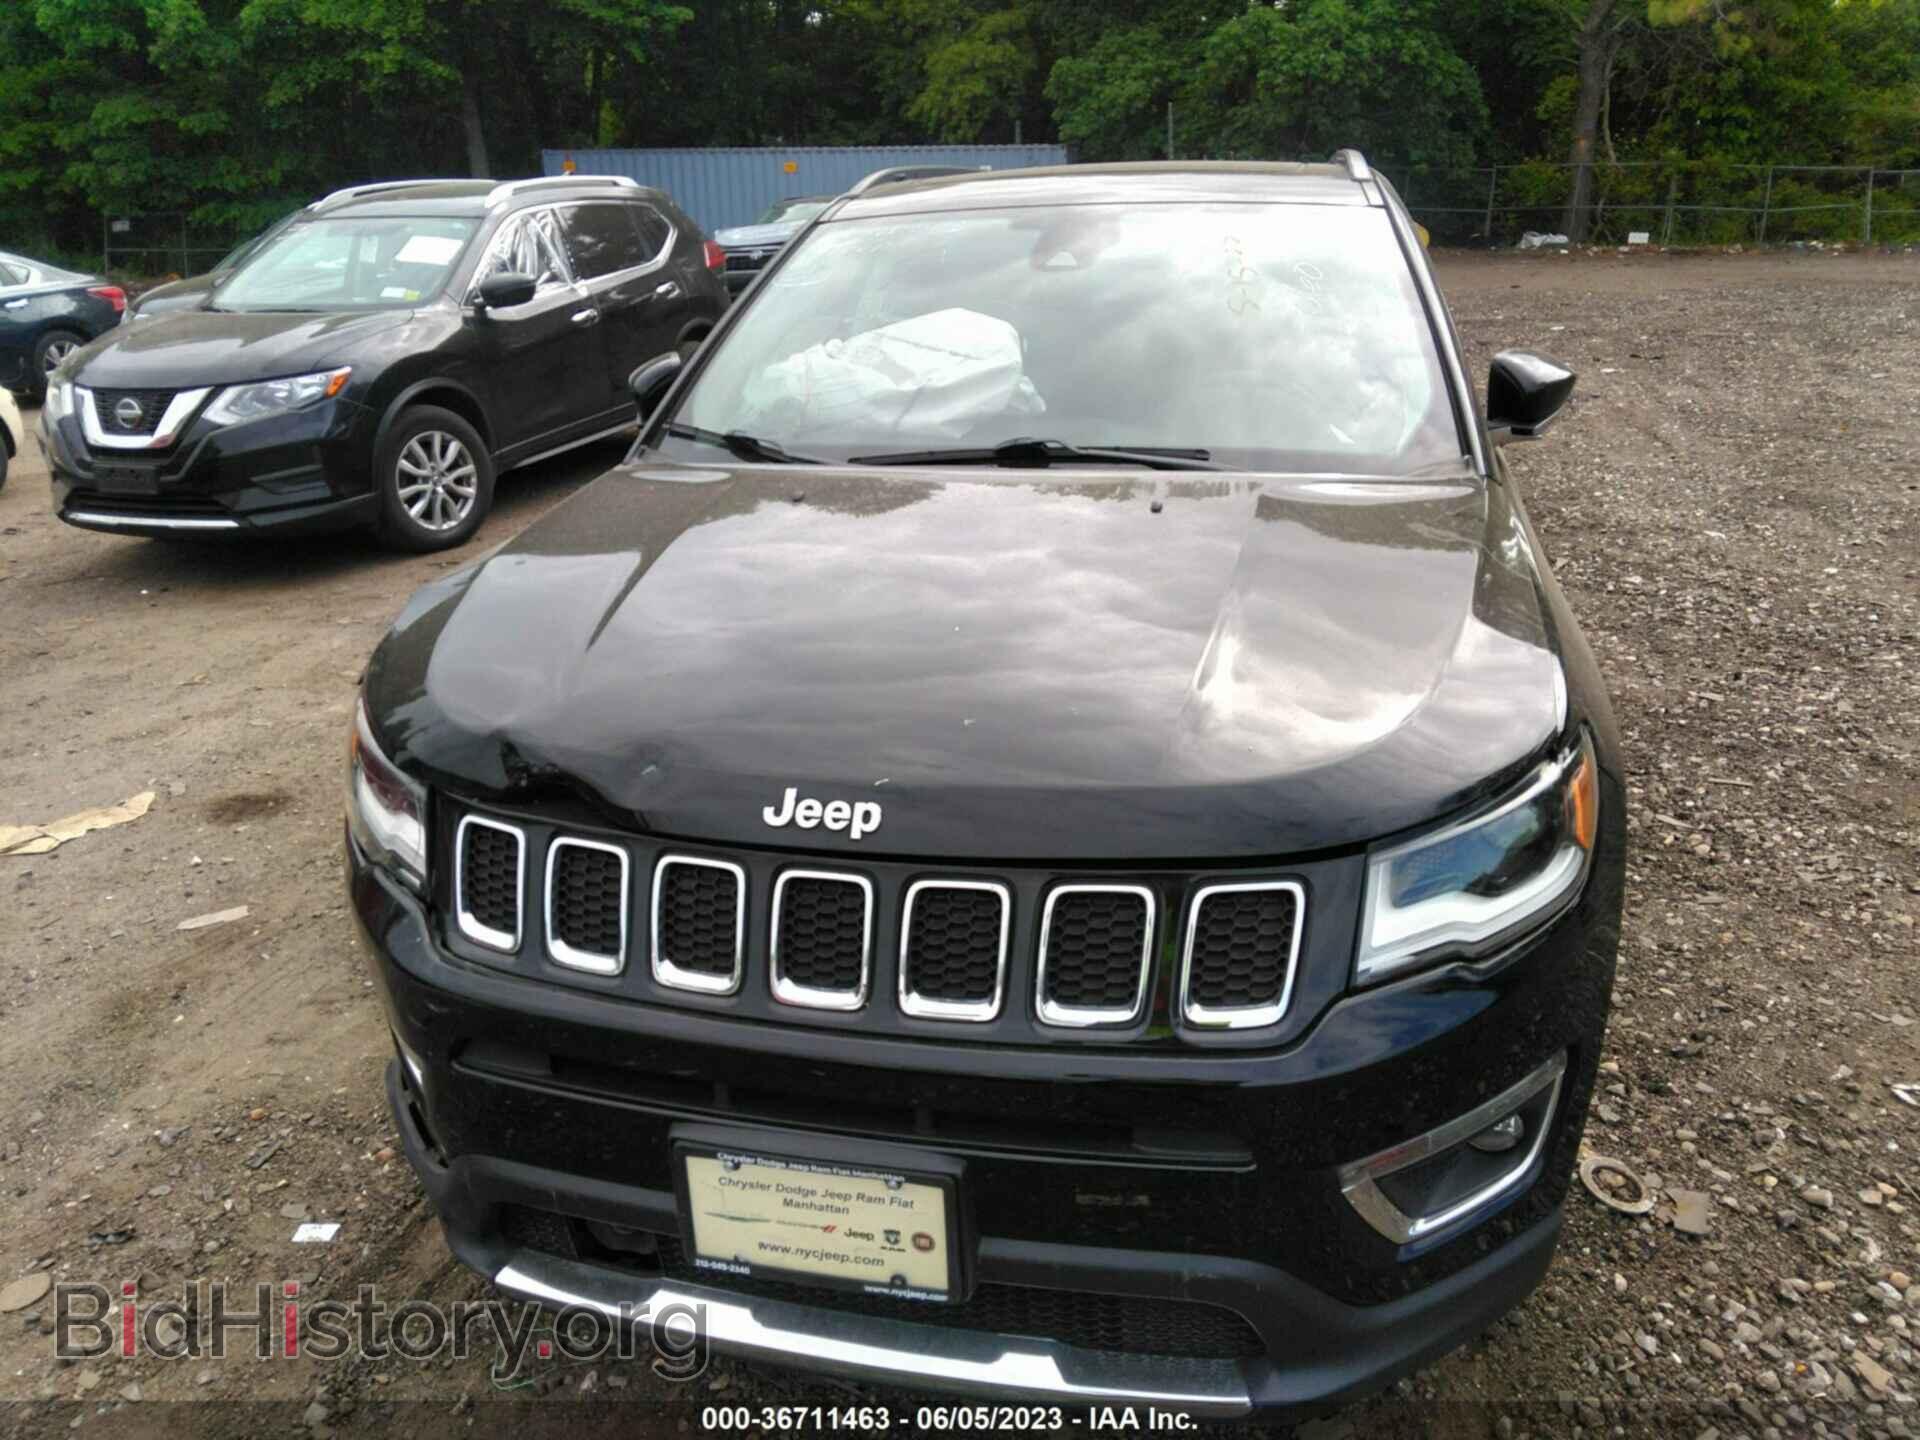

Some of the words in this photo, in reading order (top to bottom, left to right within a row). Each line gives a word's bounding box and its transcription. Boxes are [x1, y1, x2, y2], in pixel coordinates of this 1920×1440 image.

[762, 787, 882, 839] Jeep
[716, 1152, 755, 1165] Chrysler
[757, 1157, 787, 1169] Dodge
[788, 1161, 809, 1174] Jeep
[811, 1164, 832, 1174] Ram
[833, 1167, 850, 1176] Fiat
[852, 1169, 906, 1182] Manhattan
[717, 1176, 772, 1193] Chrysler
[775, 1183, 818, 1199] Dodge
[820, 1188, 853, 1203] Jeep
[855, 1192, 886, 1205] Ram
[889, 1196, 915, 1209] Fiat
[782, 1197, 850, 1215] Manhattan
[843, 1228, 876, 1243] Jeep
[757, 1240, 886, 1267] www.nycjeep.com
